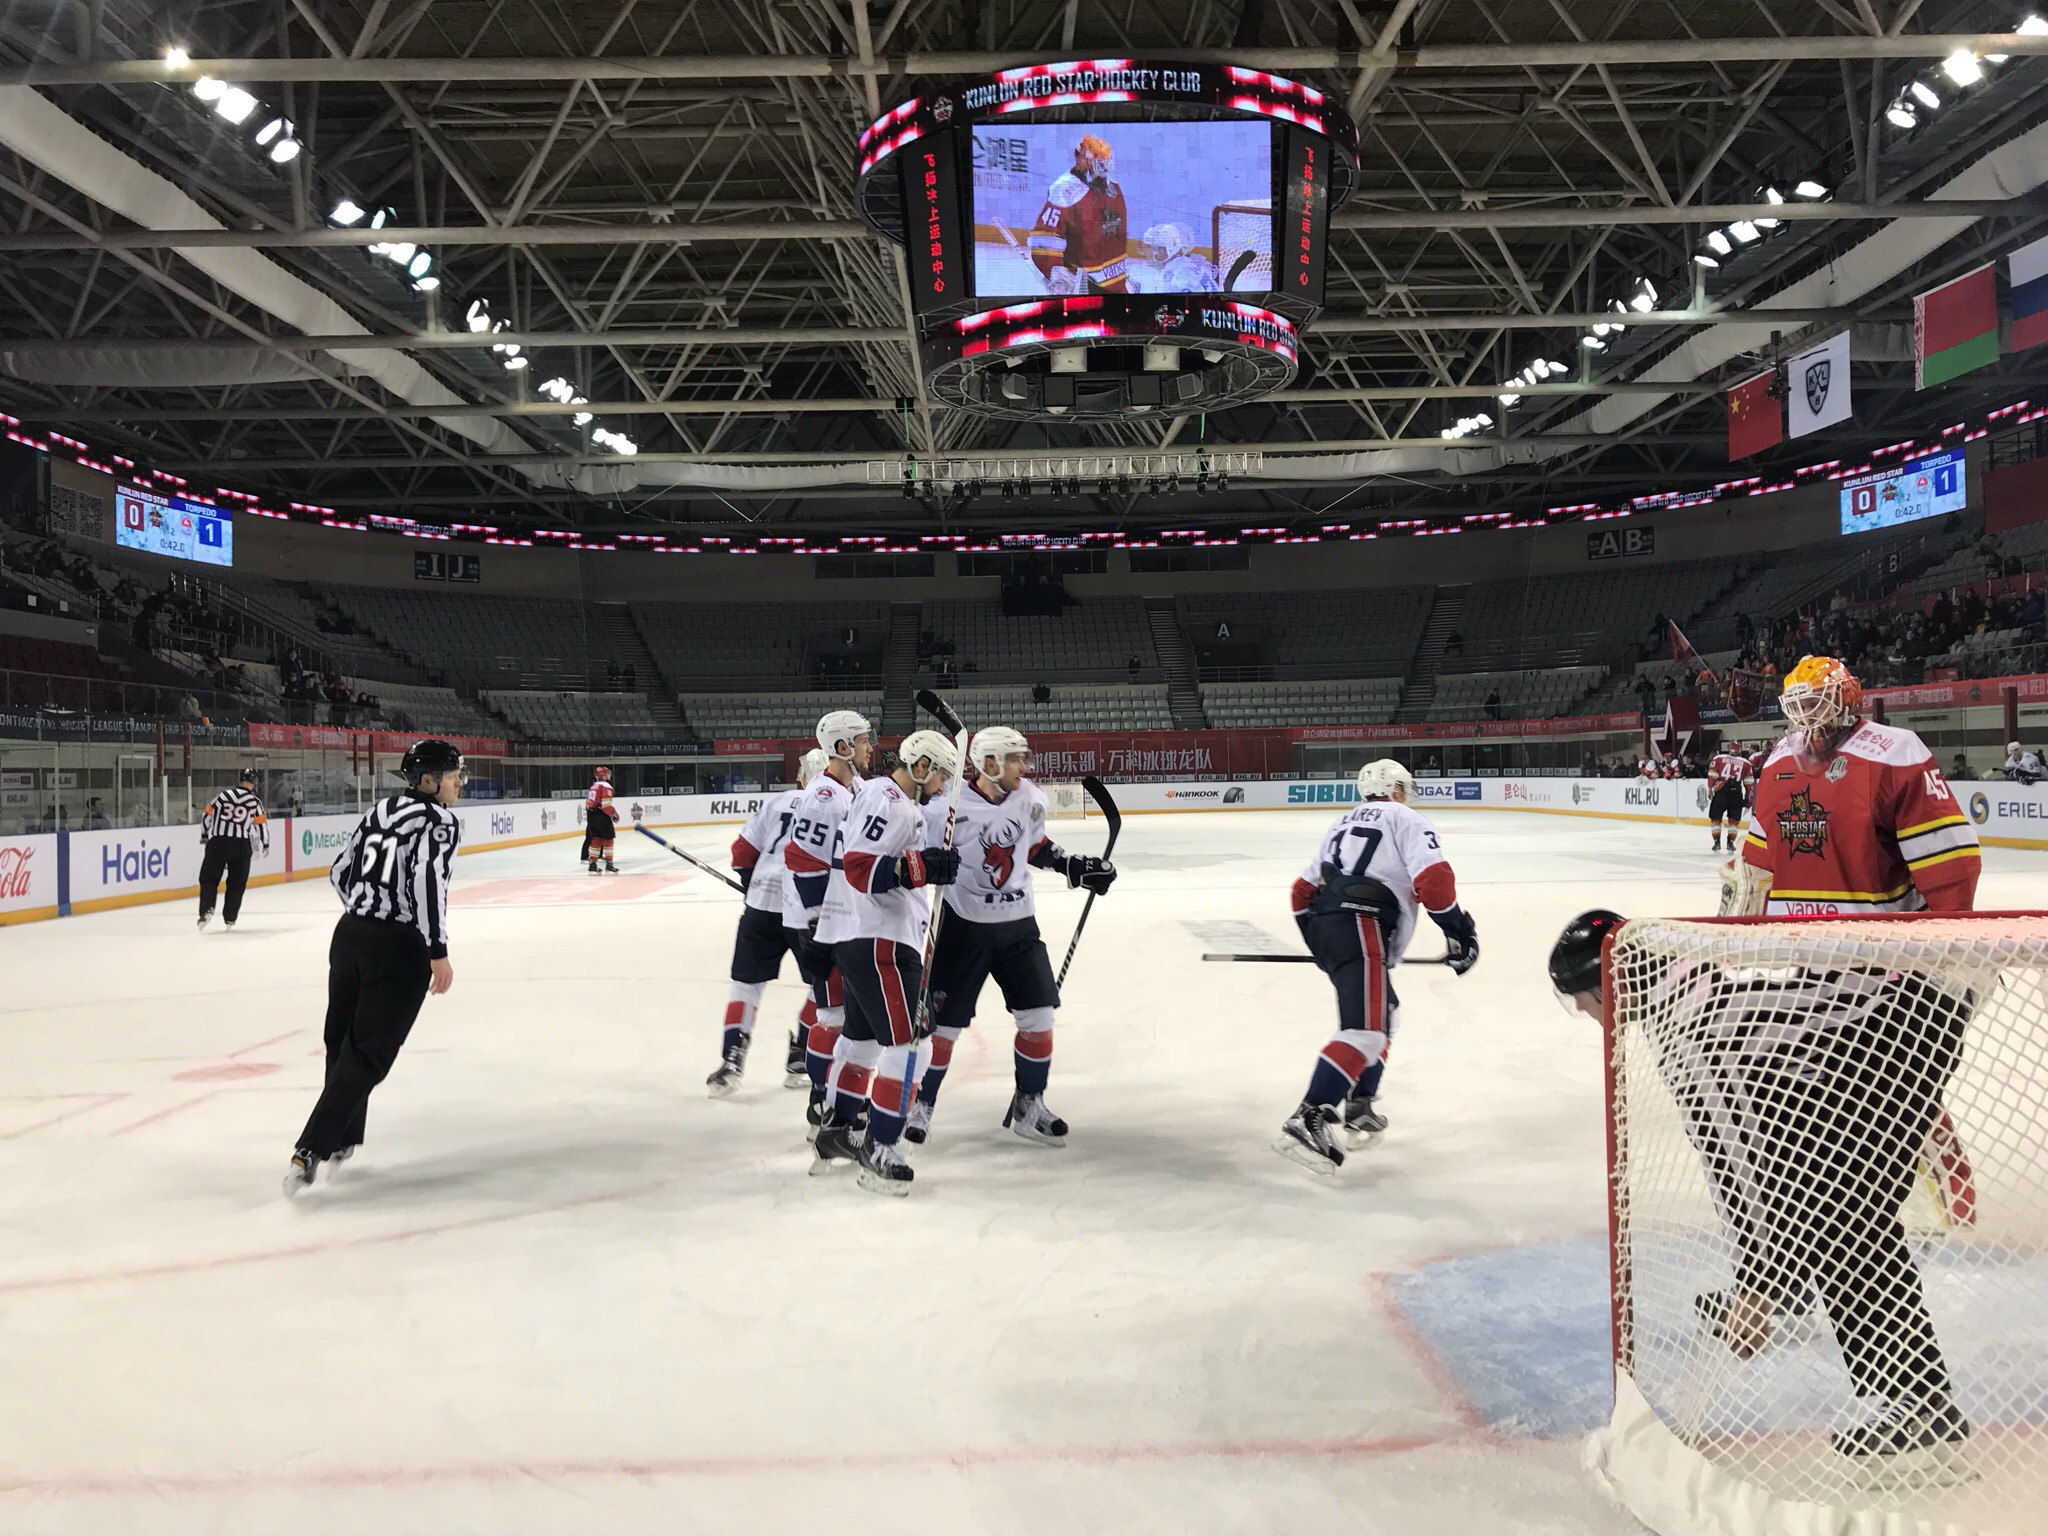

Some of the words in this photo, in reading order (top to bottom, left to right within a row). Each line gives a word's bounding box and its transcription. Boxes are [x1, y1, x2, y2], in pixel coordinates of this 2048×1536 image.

[966, 80, 1019, 109] KUNLUN
[1023, 78, 1051, 98] RED
[1056, 71, 1095, 94] STAR
[1100, 70, 1159, 90] HOCKEY
[1163, 70, 1201, 92] CLUB
[1041, 207, 1061, 228] 45
[1202, 308, 1257, 334] KUNLUN
[1259, 319, 1278, 341] RED
[1920, 454, 1952, 470] TORPEDO
[1843, 474, 1872, 488] KUNLUN
[1872, 472, 1886, 482] RED
[1886, 467, 1904, 479] STAR
[1941, 470, 1950, 490] 1
[117, 485, 140, 499] KUNLUN
[140, 491, 153, 502] RED
[153, 494, 169, 506] STAR
[1858, 490, 1870, 511] 0
[1906, 494, 1911, 502] 2
[129, 504, 139, 526] 0
[185, 503, 217, 517] TORPEDO
[1895, 503, 1922, 519] 0:42.0
[205, 523, 214, 543] 1
[1599, 532, 1619, 555] A
[1626, 529, 1642, 551] B
[160, 538, 185, 552] 0:42.0
[430, 554, 440, 576] I
[452, 555, 463, 578] J
[846, 630, 854, 644] J
[1217, 623, 1230, 637] A
[93, 720, 124, 732] LEAGUE
[1856, 730, 1893, 751] 昆仑山
[1417, 786, 1453, 796] OGAZ
[1505, 783, 1527, 801] 昆仑山
[1924, 769, 1949, 800] 45
[1625, 787, 1660, 806] KHL.RU
[220, 802, 248, 823] 39
[491, 811, 515, 835] Haier
[795, 818, 829, 846] 25
[861, 814, 888, 842] 16
[314, 832, 352, 849] MEGAFO
[432, 824, 455, 843] 61
[102, 839, 171, 884] Haier
[362, 833, 398, 884] 61
[1085, 859, 1094, 871] 72
[1786, 902, 1839, 915] vanke
